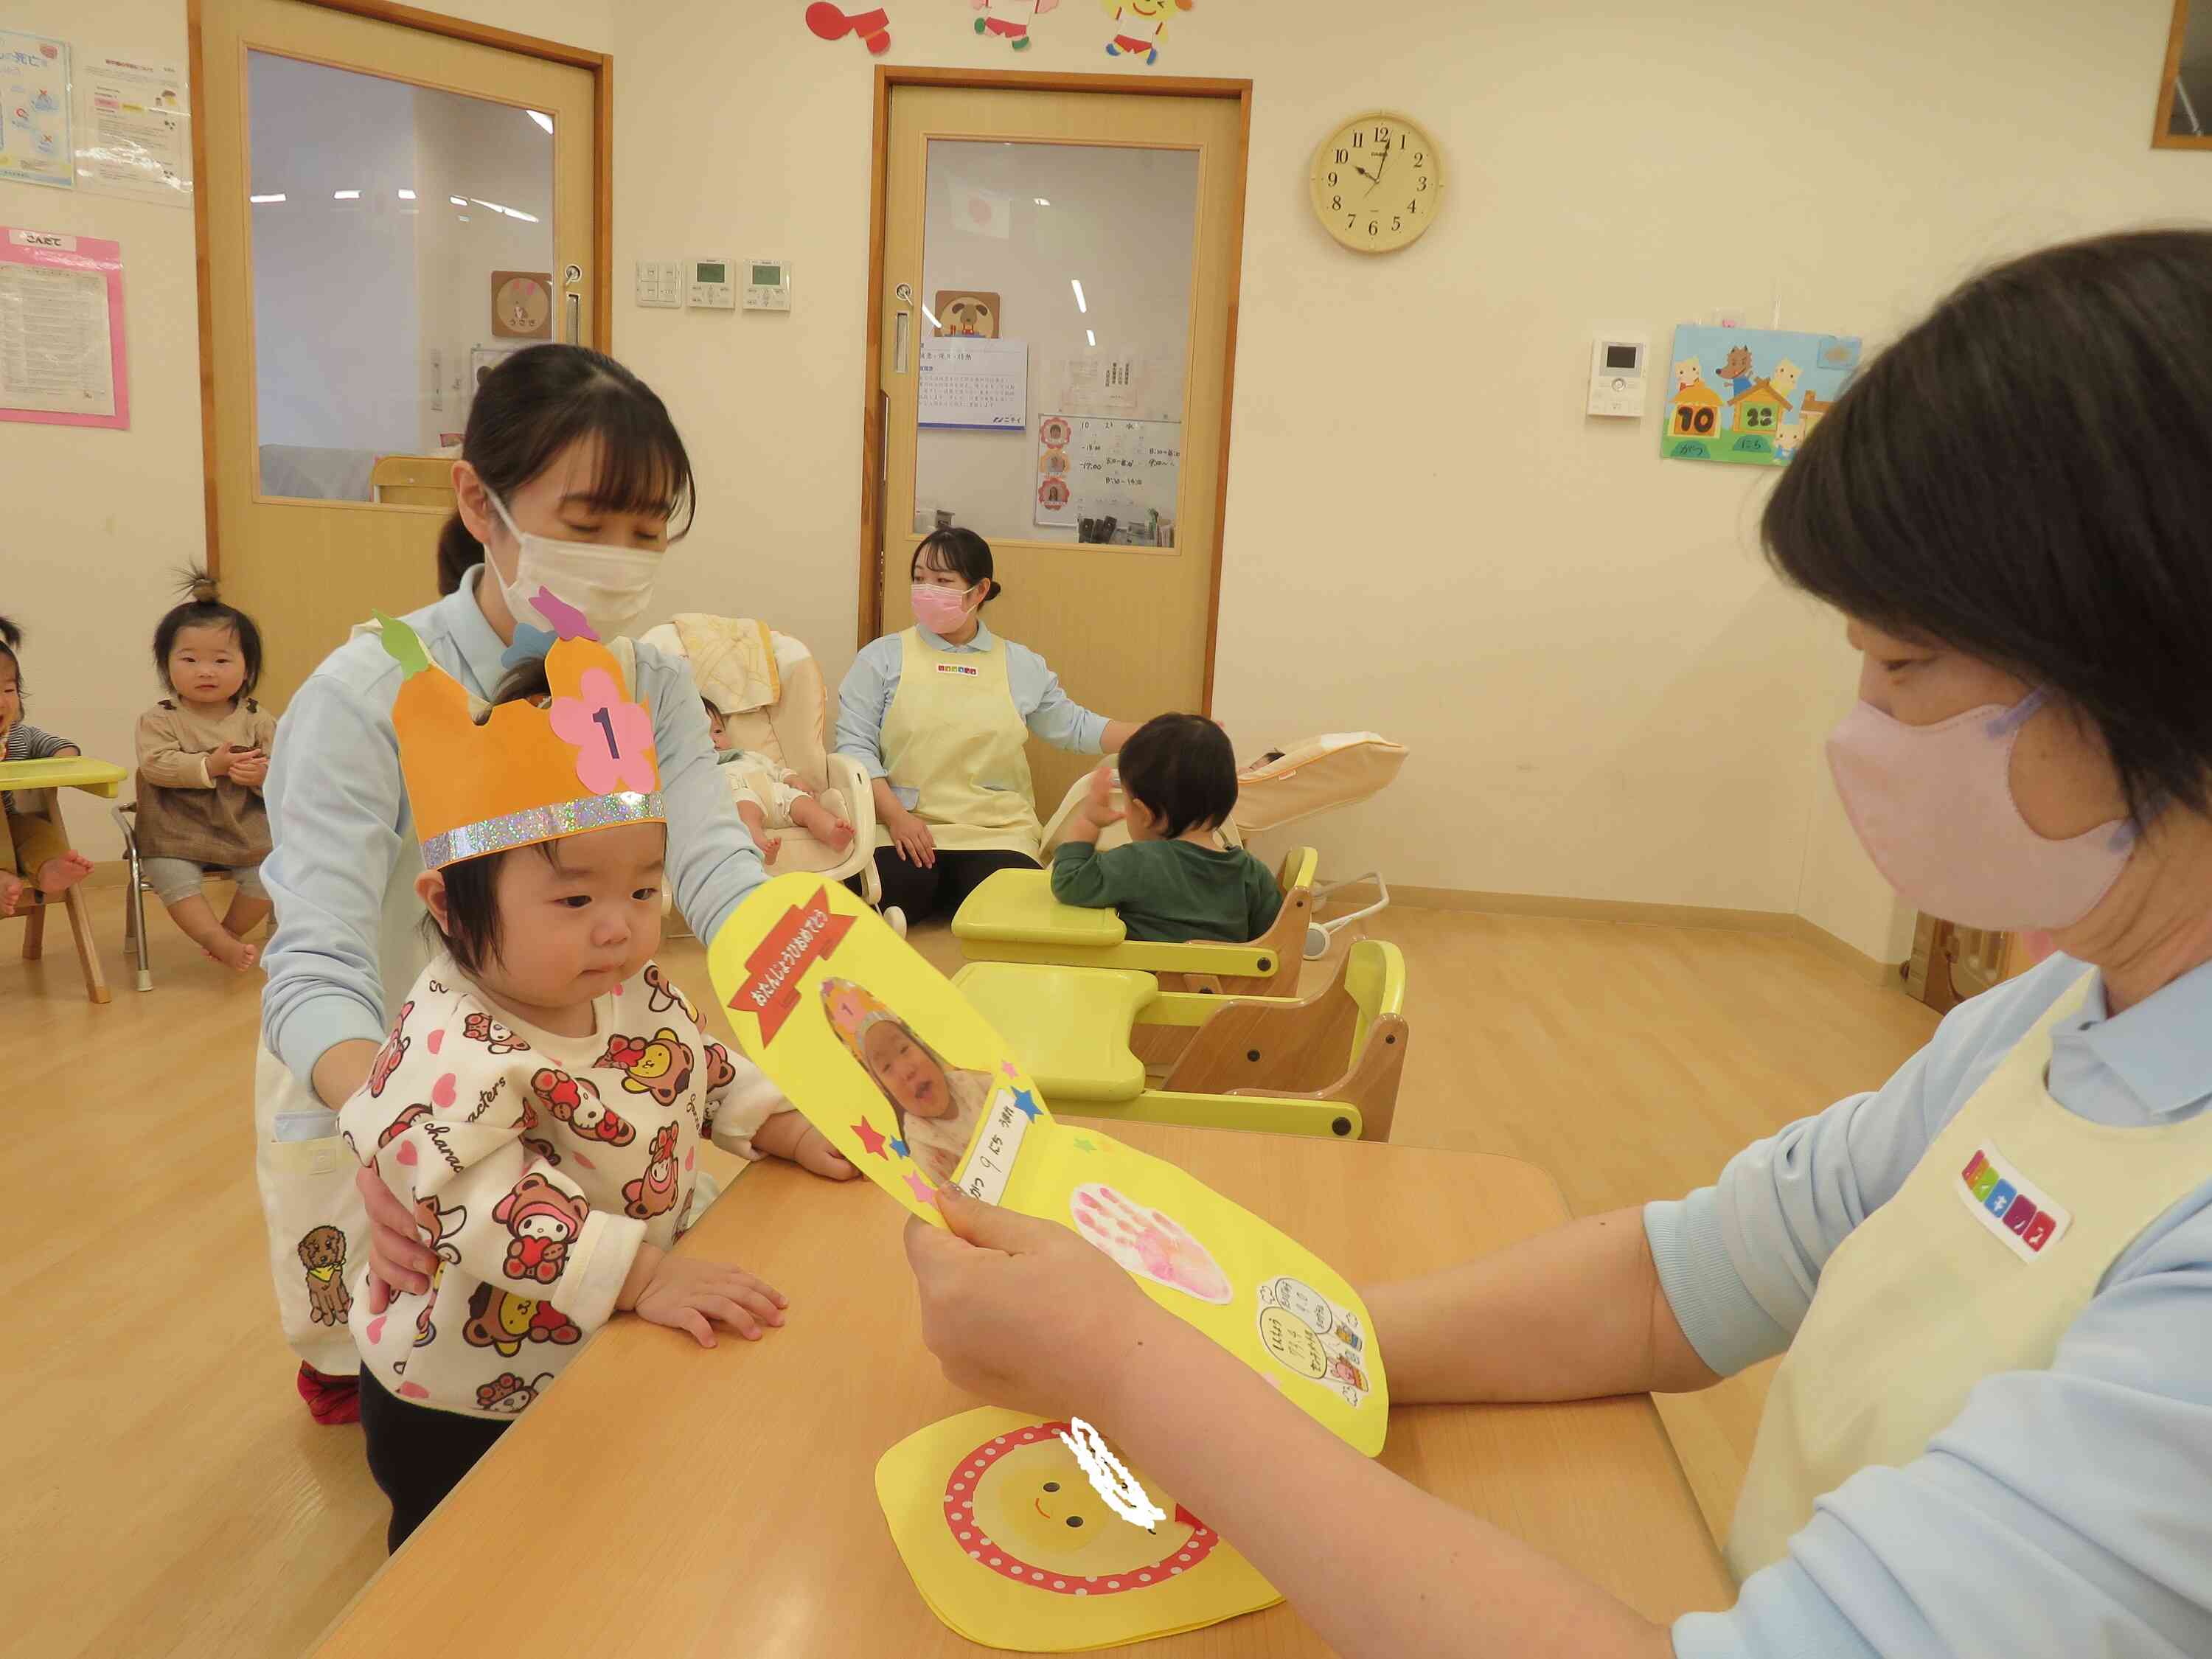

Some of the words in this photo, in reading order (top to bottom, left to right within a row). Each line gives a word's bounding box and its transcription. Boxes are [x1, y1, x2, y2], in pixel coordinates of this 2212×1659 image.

[1352, 132, 1363, 148] 11
[1374, 127, 1389, 142] 12
[1400, 135, 1406, 150] 1
[1334, 148, 1349, 164] 10
[1413, 153, 1424, 168] 2
[1327, 172, 1338, 187] 9
[1416, 176, 1427, 192] 3
[1332, 195, 1342, 211] 8
[1407, 198, 1416, 214] 4
[1347, 214, 1357, 229] 7
[1368, 220, 1378, 235] 6
[1391, 217, 1401, 232] 5
[27, 234, 62, 247] こんだて
[1678, 406, 1714, 433] 10
[1680, 442, 1703, 456] がつ
[1741, 439, 1761, 450] にち
[592, 707, 620, 759] 1
